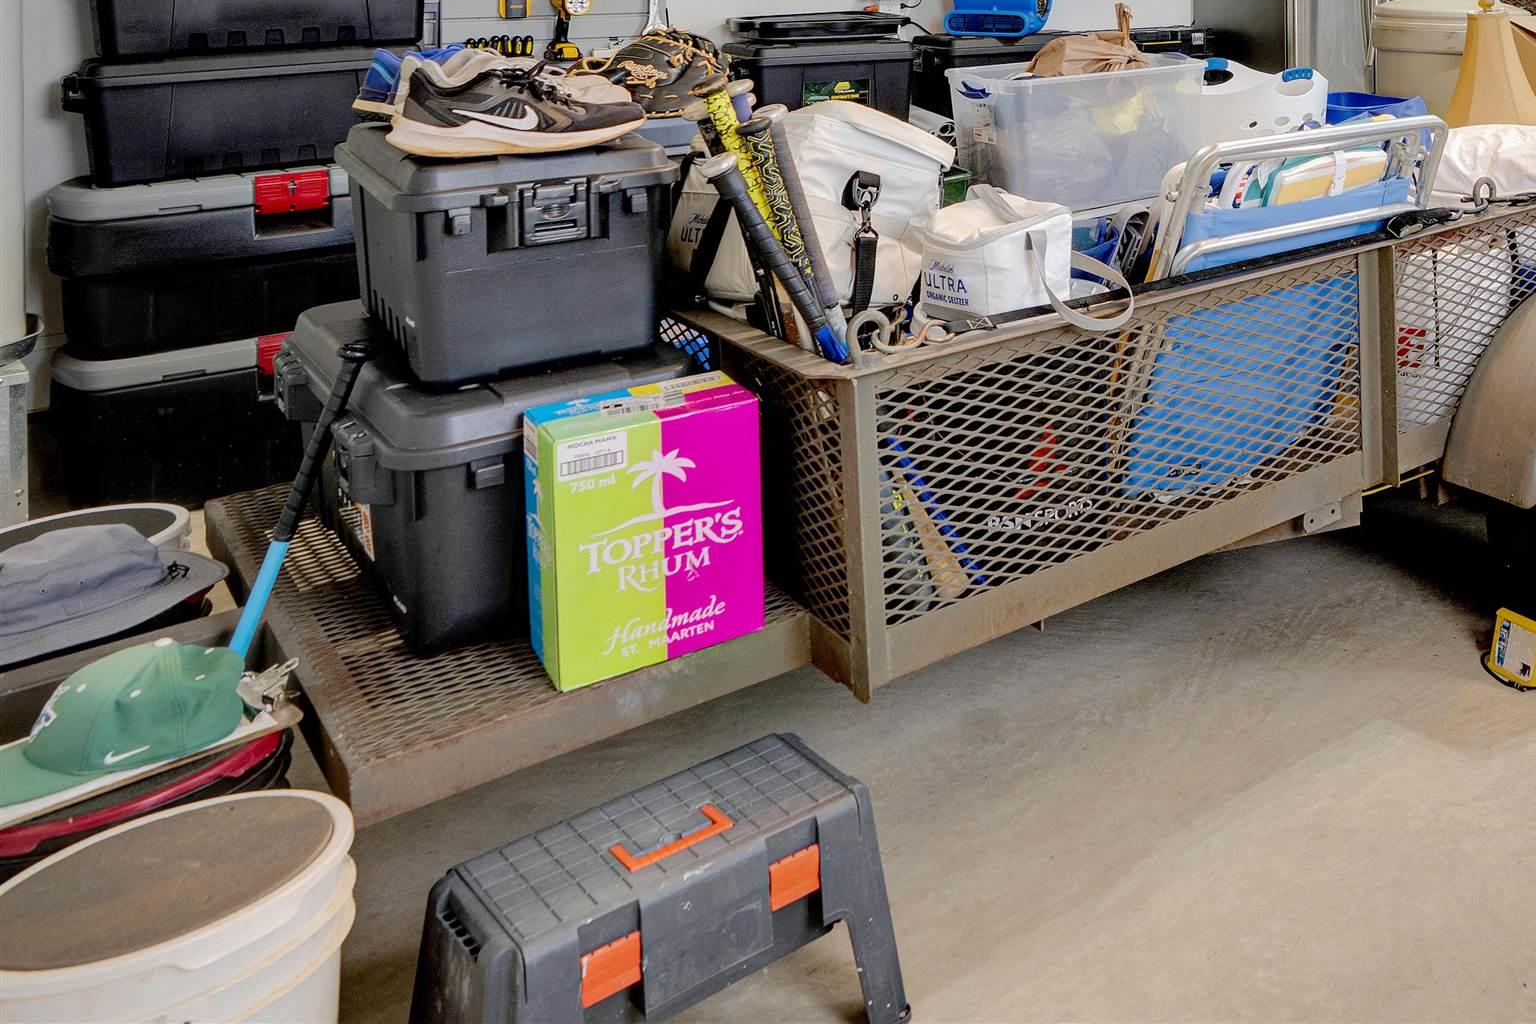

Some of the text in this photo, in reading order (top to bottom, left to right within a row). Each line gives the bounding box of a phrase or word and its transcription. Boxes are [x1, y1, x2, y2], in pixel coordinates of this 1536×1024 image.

[680, 226, 703, 248] ULT
[923, 272, 968, 294] ULTRA
[926, 290, 969, 306] ORGANIC SELTZER
[566, 434, 617, 451] MOCHA MAMA
[569, 474, 617, 494] 750 ml
[578, 506, 744, 576] TOPPER'S
[616, 545, 711, 593] RHUM
[602, 595, 725, 657] Handmade
[620, 619, 715, 658] ST. MAARTEN
